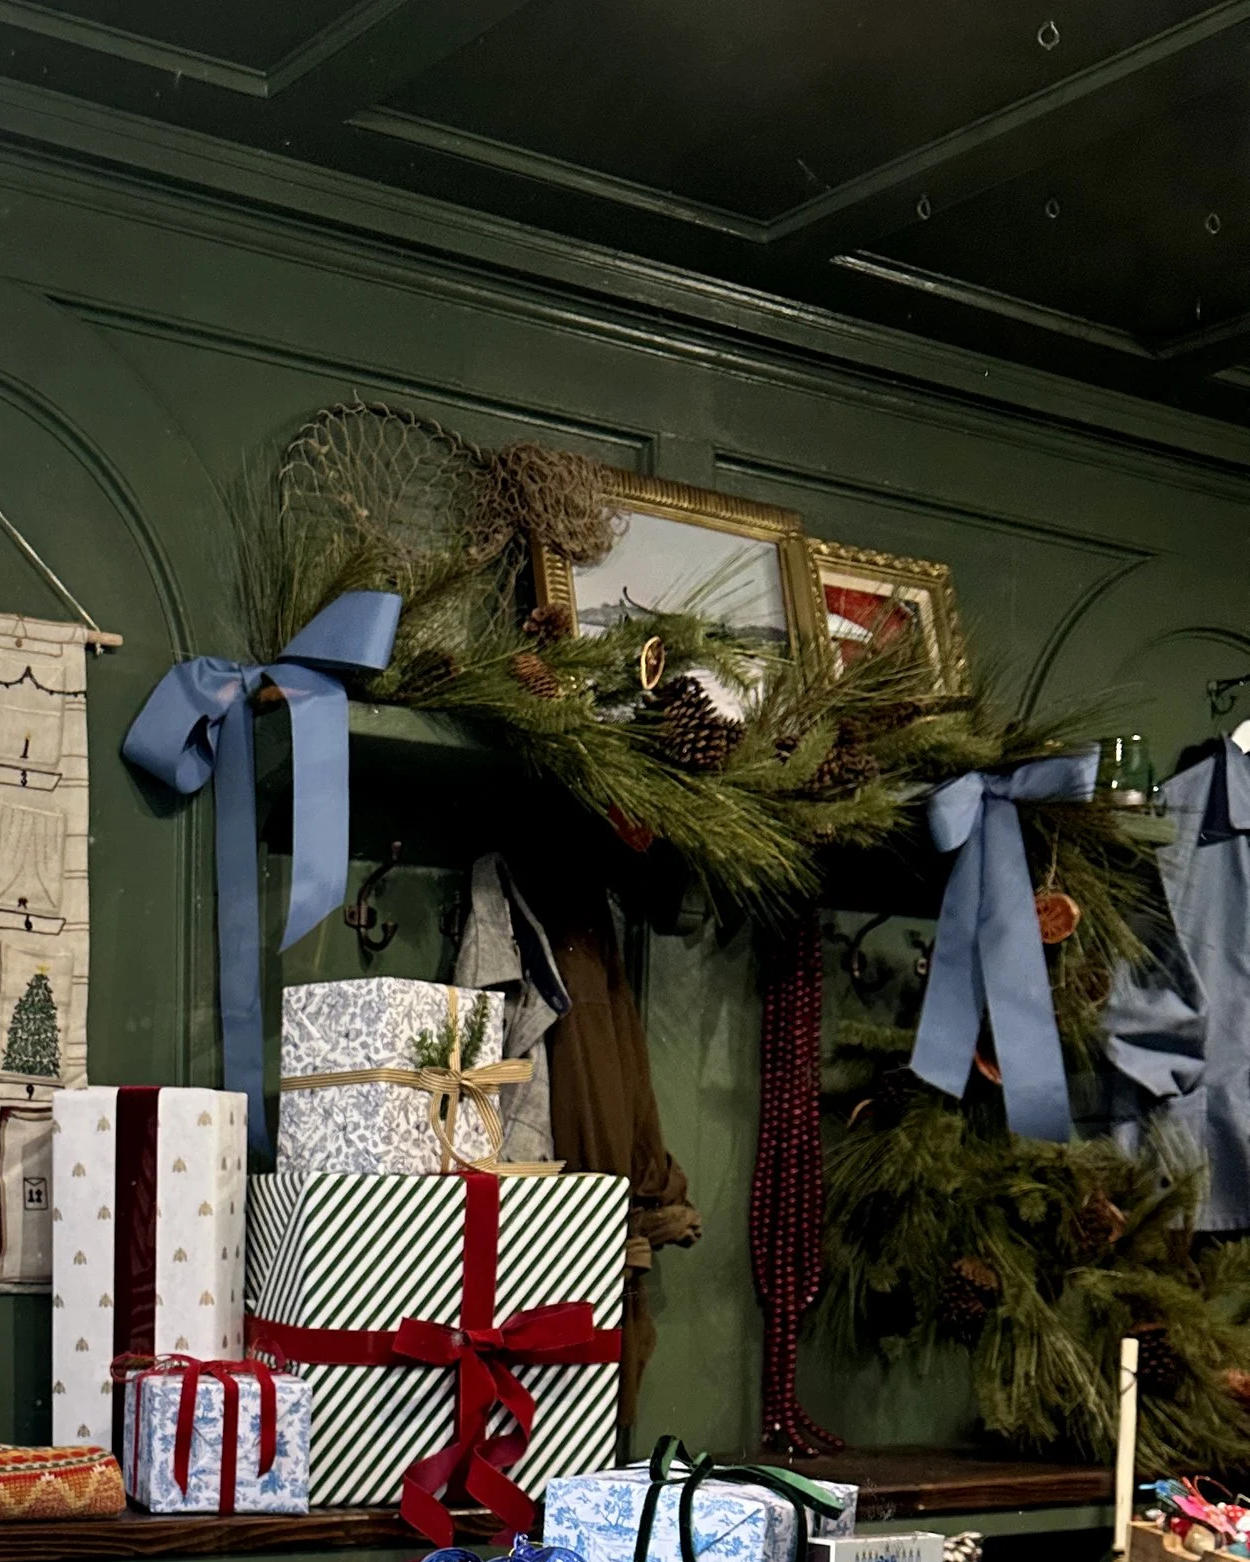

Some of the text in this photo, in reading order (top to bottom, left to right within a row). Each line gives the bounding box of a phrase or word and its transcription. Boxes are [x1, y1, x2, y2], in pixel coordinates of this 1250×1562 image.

[20, 770, 28, 787] 3
[25, 914, 33, 931] 6
[26, 1085, 34, 1100] 9
